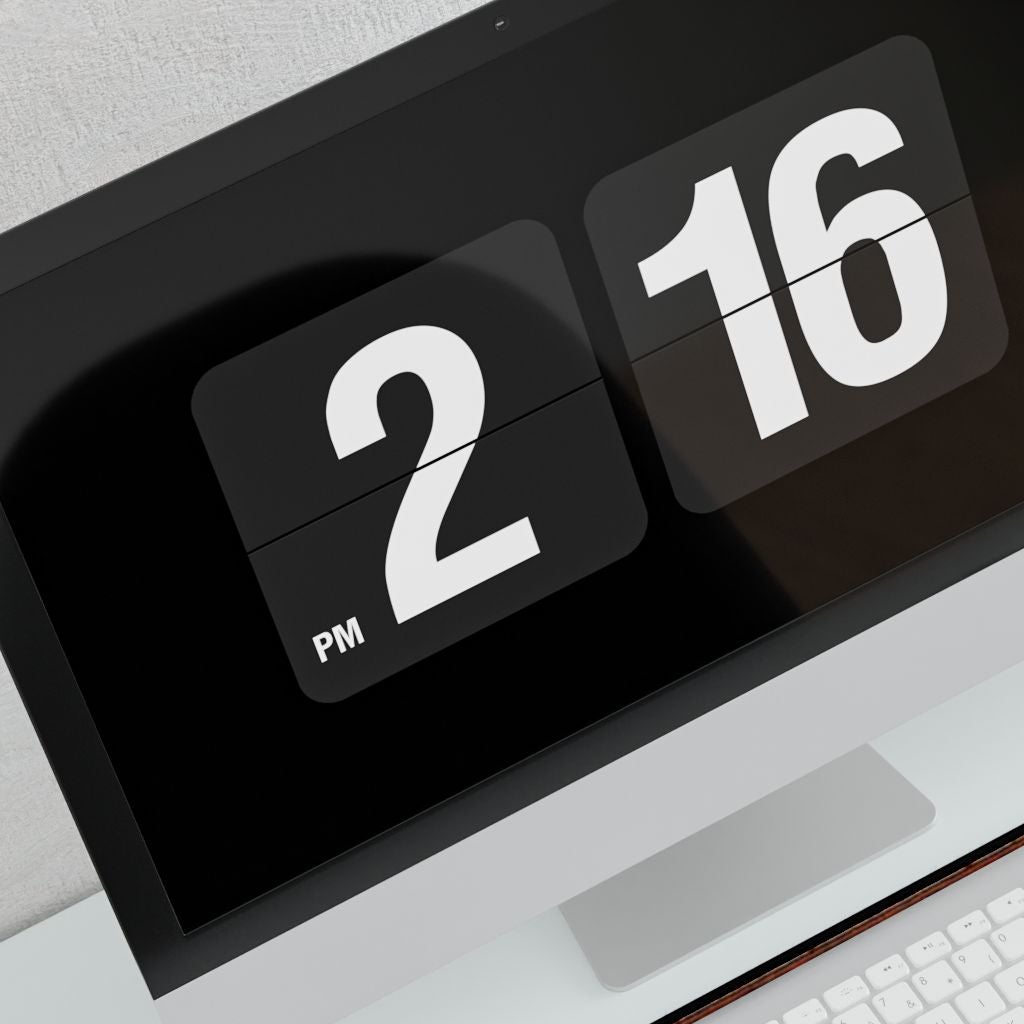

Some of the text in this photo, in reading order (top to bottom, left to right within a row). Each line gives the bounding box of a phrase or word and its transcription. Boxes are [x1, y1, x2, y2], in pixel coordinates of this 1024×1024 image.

[325, 107, 948, 625] 2 16
[312, 617, 365, 663] PM
